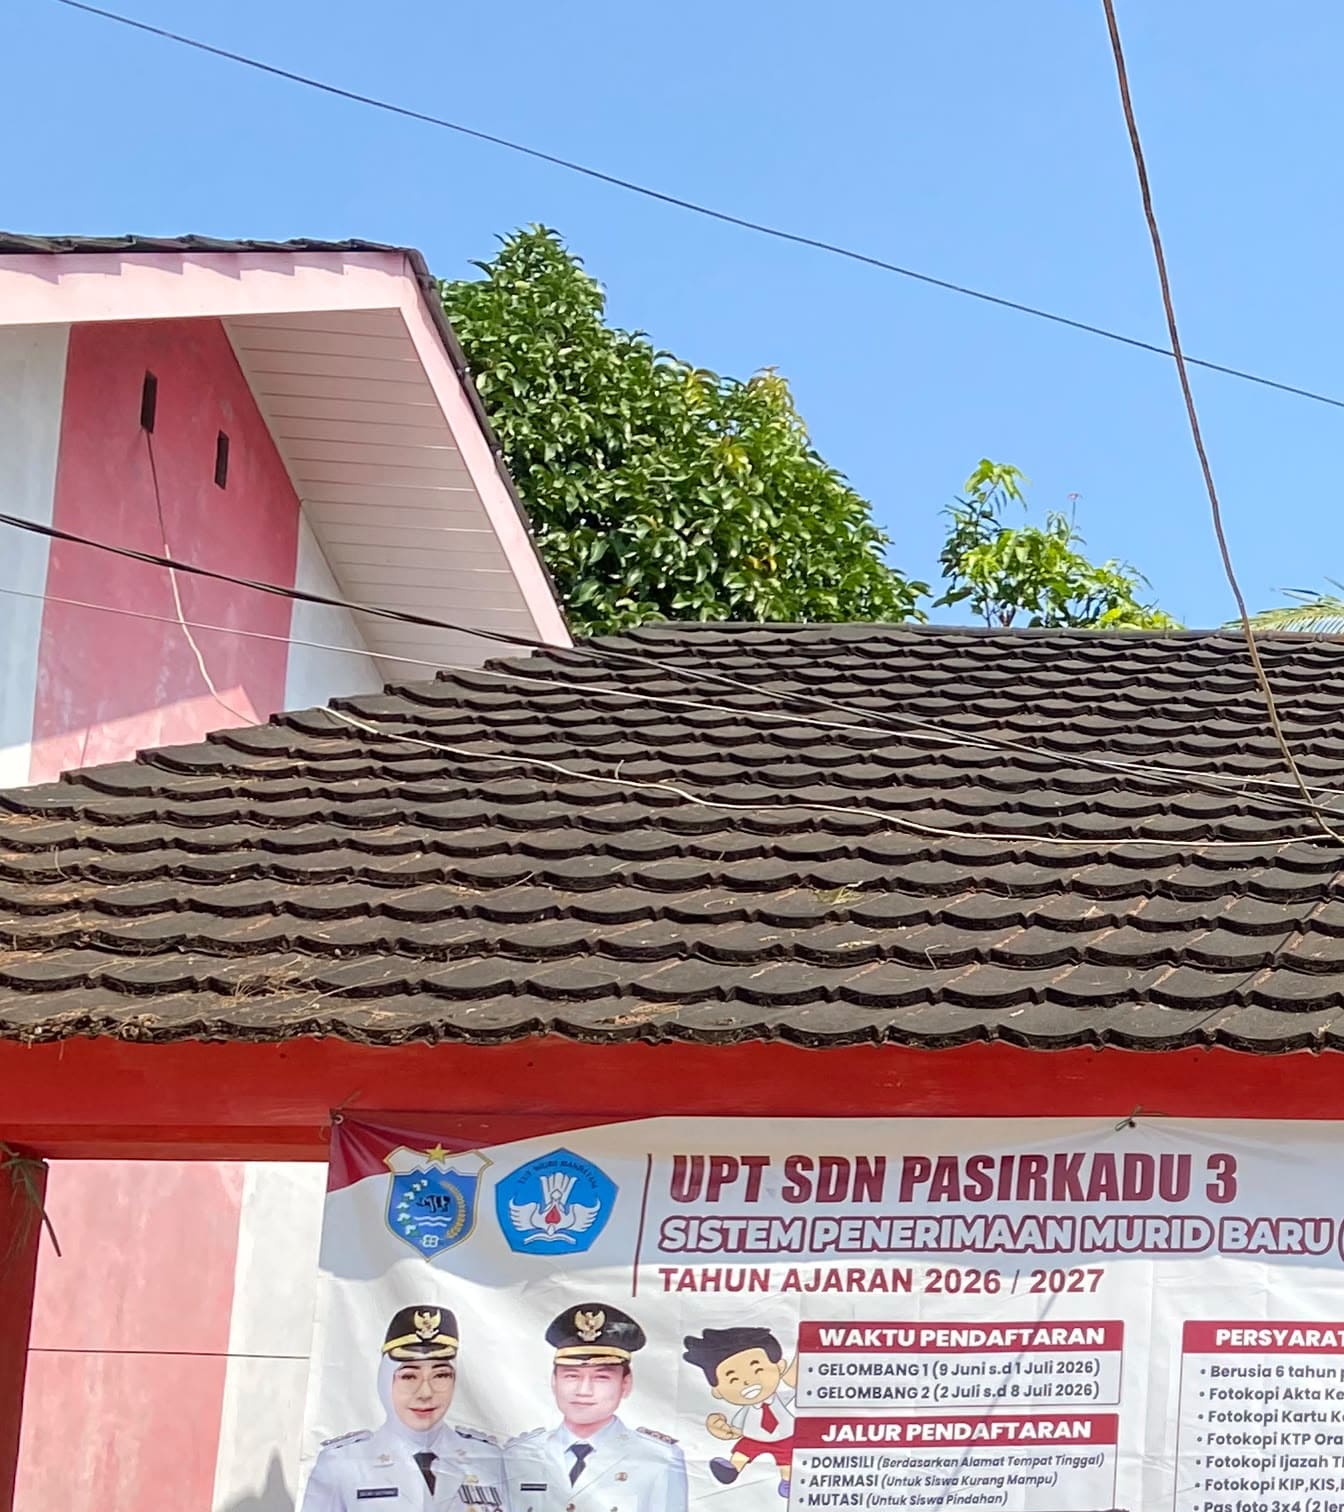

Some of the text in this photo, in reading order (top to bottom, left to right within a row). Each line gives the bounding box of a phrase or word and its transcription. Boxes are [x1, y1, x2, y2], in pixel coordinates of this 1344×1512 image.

[670, 1153, 1237, 1203] UPT SDN PASIRKADU 3
[658, 1215, 806, 1253] SISTEM
[810, 1215, 1076, 1253] PENERIMAAN
[1080, 1215, 1215, 1253] MURID
[1218, 1216, 1334, 1255] BARU
[659, 1268, 1104, 1294] TAHUN AJARAN 2026 / 2027
[819, 1327, 1105, 1347] WAKTU PENDAFTARAN
[817, 1359, 1100, 1379] GELOMBANG 1 (9 Juni s.d 1 Juli 2026)
[1210, 1364, 1272, 1378] Berusia
[1275, 1365, 1284, 1378] 6
[1289, 1365, 1336, 1378] tahun
[816, 1381, 1100, 1403] GELOMBANG 2 (2 Juli s.d 8 Juli 2026)
[1209, 1387, 1279, 1404] Fotokopi
[1282, 1387, 1321, 1400] Akta
[1208, 1409, 1278, 1427] Fotokopi
[1281, 1410, 1327, 1423] Kartu
[821, 1421, 1091, 1442] JALUR PENDAFTARAN
[1206, 1432, 1277, 1450] Fotokopi
[1280, 1434, 1311, 1445] KTP
[811, 1453, 1105, 1471] DOMISILI (Berdasarkan Alamat Tempat Tinggal)
[1205, 1455, 1277, 1473] Fotokopi
[1280, 1455, 1328, 1472] Ijazah
[808, 1473, 1058, 1490] AFIRMASI (Untuk Siswa Kurang Mampu)
[1204, 1477, 1275, 1496] Fotokopi
[808, 1492, 1008, 1509] MUTASI (Untuk Siswa Pindahan)
